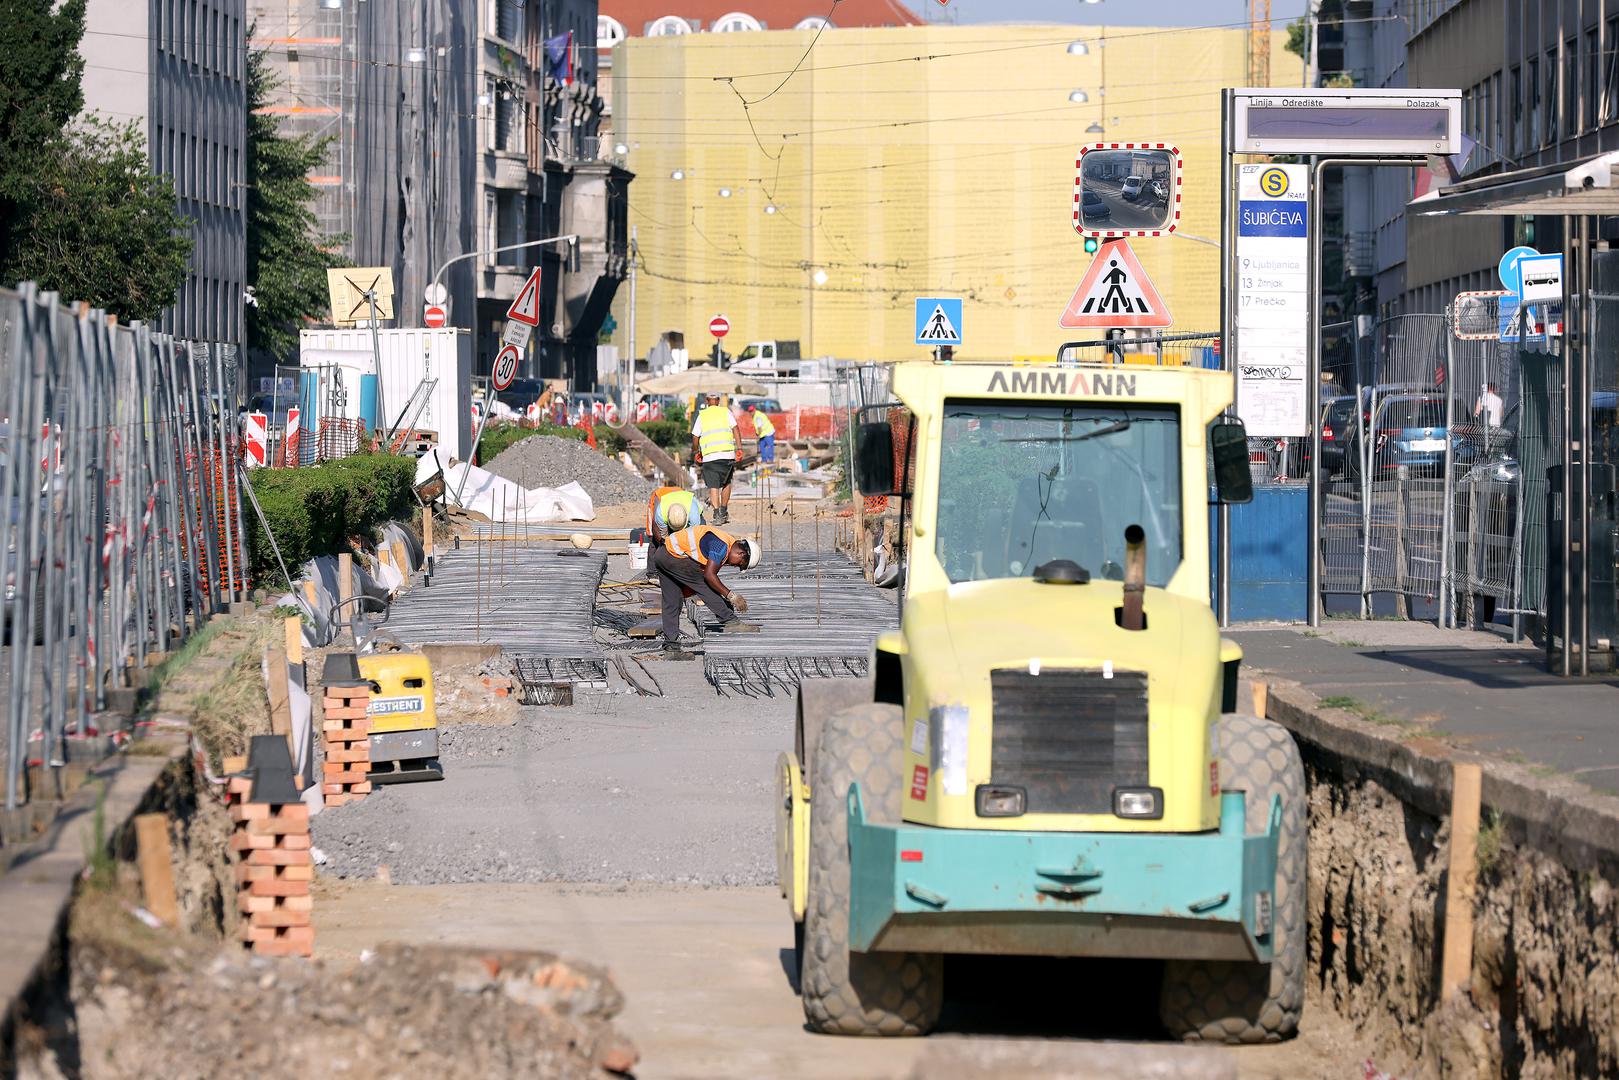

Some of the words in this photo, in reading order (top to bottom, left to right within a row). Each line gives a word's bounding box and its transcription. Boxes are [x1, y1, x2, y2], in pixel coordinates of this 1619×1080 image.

[1250, 98, 1273, 108] Linija
[1282, 98, 1324, 107] Odredište
[1406, 99, 1440, 108] Dolazak
[1267, 173, 1282, 192] S
[1243, 208, 1304, 226] ŠUBIĆEVA
[1242, 258, 1251, 270] 9
[1242, 277, 1253, 289] 13
[1241, 295, 1252, 307] 17
[1255, 296, 1287, 306] Prečko
[497, 355, 514, 380] 30
[986, 370, 1137, 397] AMMANN
